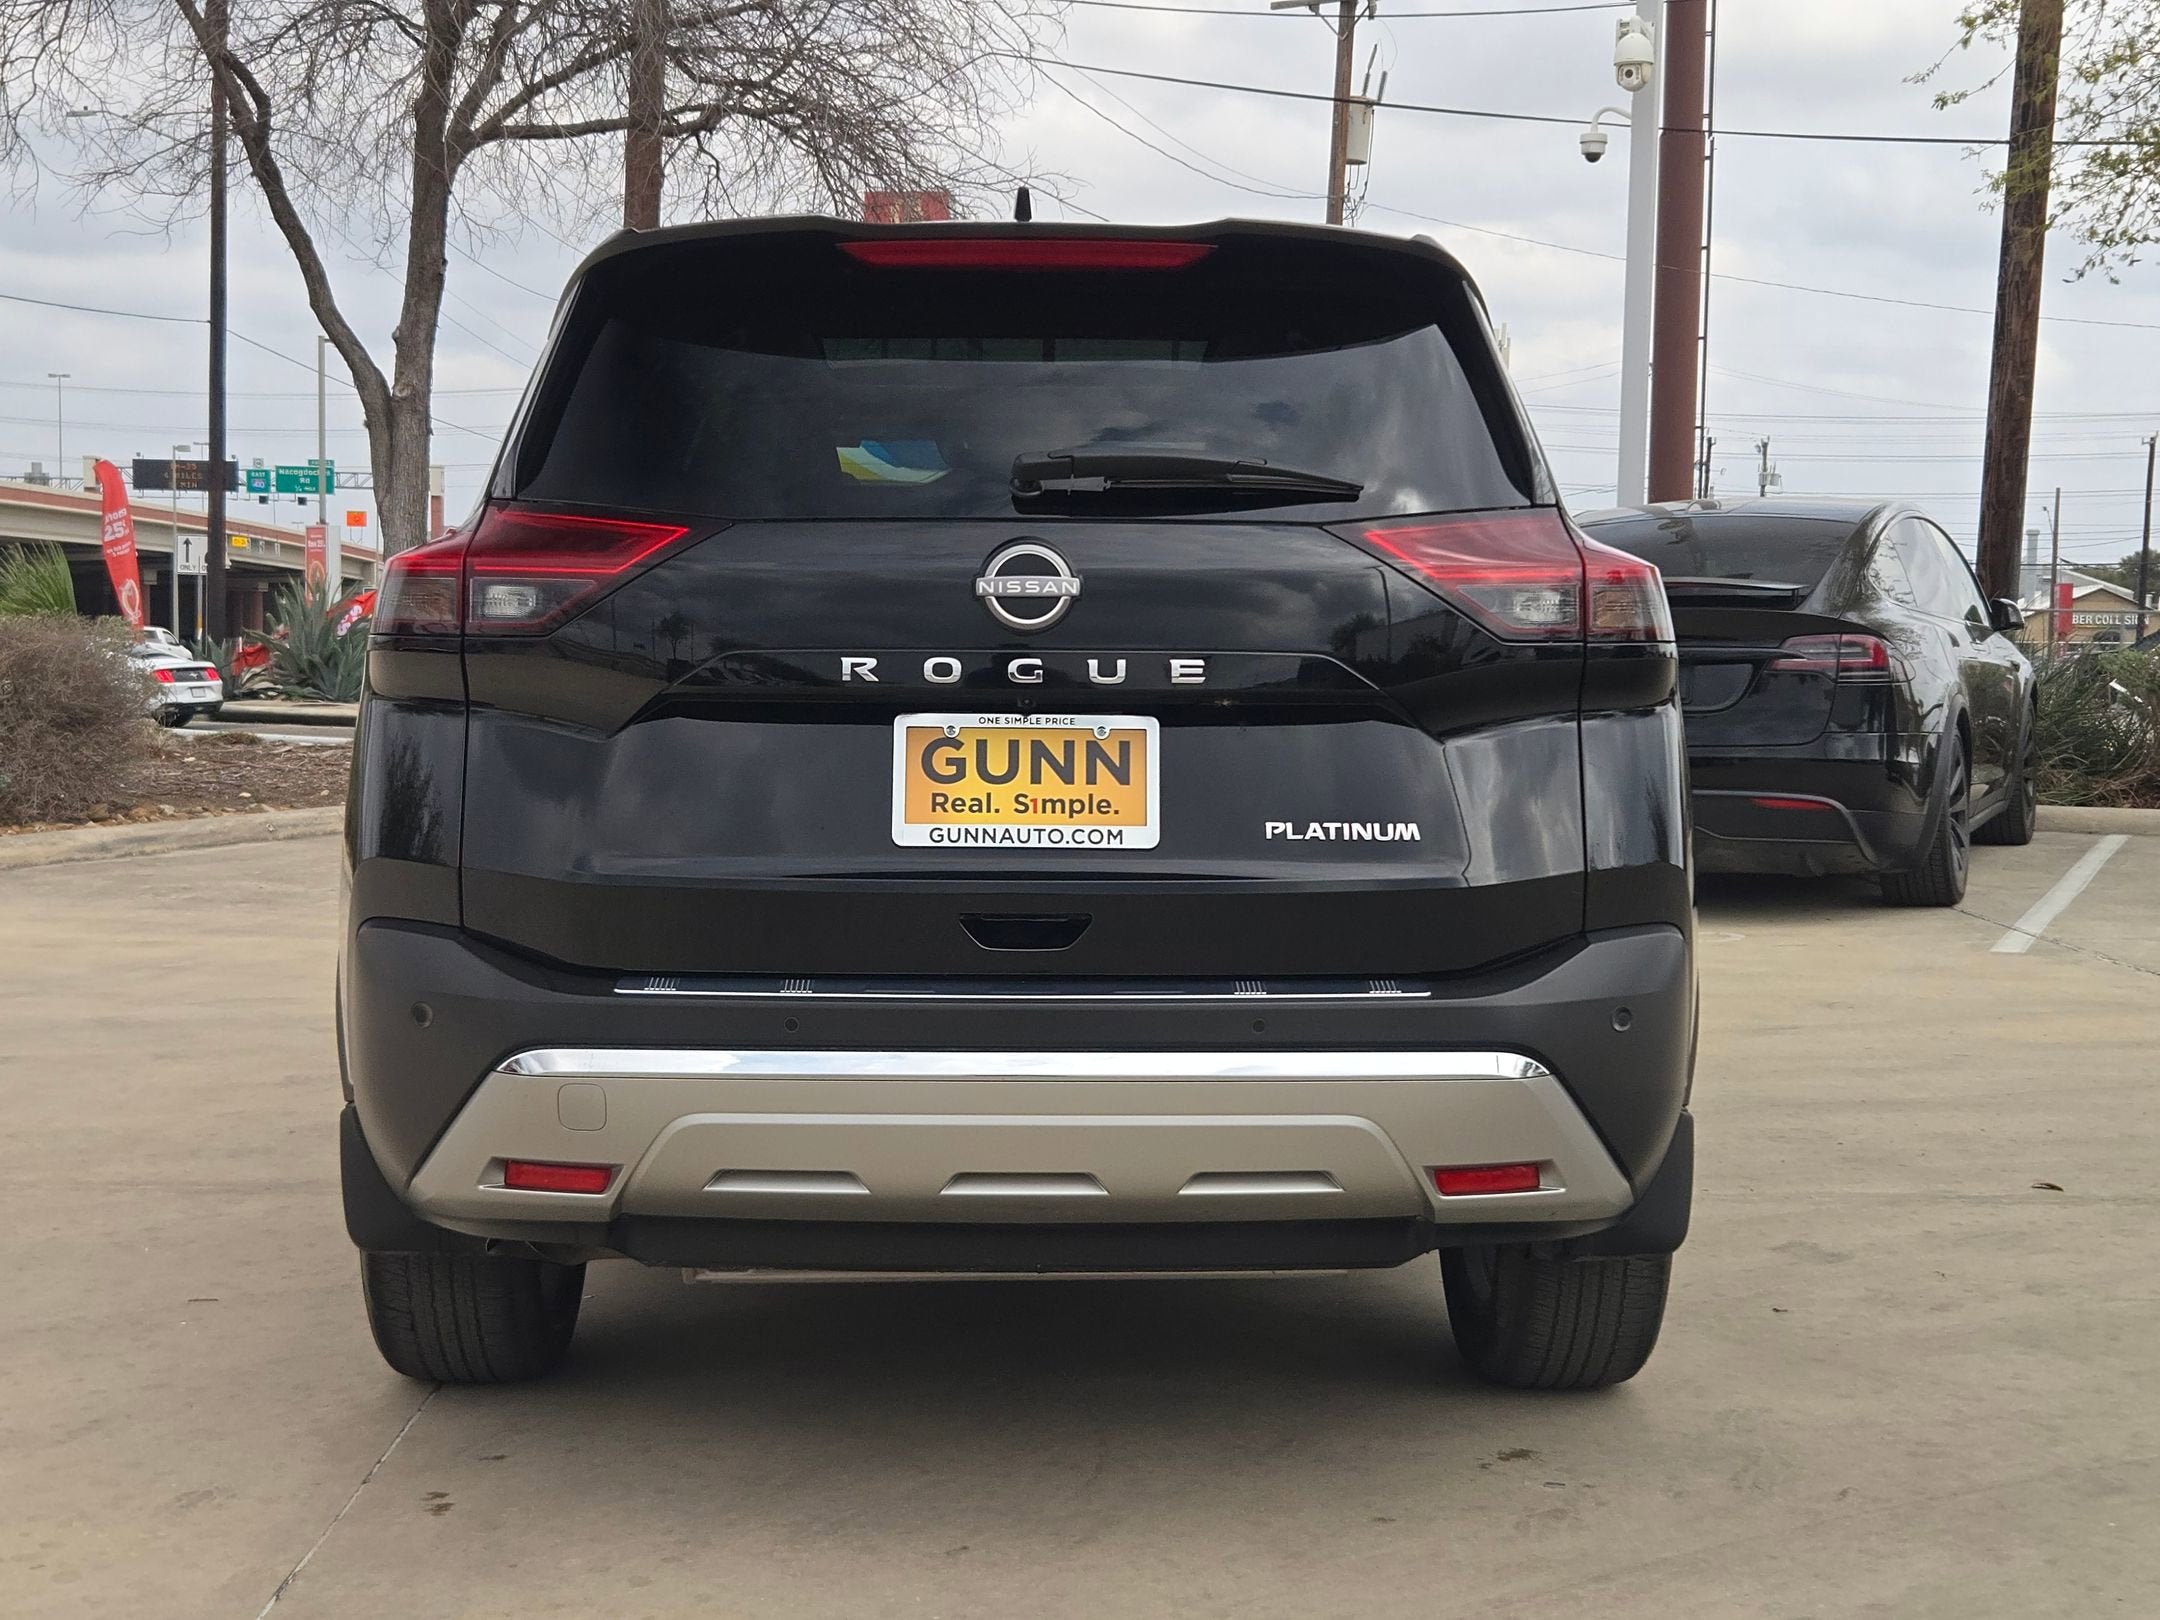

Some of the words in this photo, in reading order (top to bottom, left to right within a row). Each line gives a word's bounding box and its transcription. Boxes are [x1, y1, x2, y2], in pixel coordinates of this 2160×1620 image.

[978, 579, 1078, 594] NISSAN
[840, 656, 1206, 685] ROGUE
[978, 716, 1000, 725] ONE
[1004, 716, 1041, 726] SIMPLE
[1045, 717, 1075, 726] PRICE
[921, 737, 1131, 786] GUNN
[931, 792, 1000, 815] Real.
[929, 827, 1123, 845] GUNNAUTO.COM
[1264, 821, 1421, 841] PLATINUM
